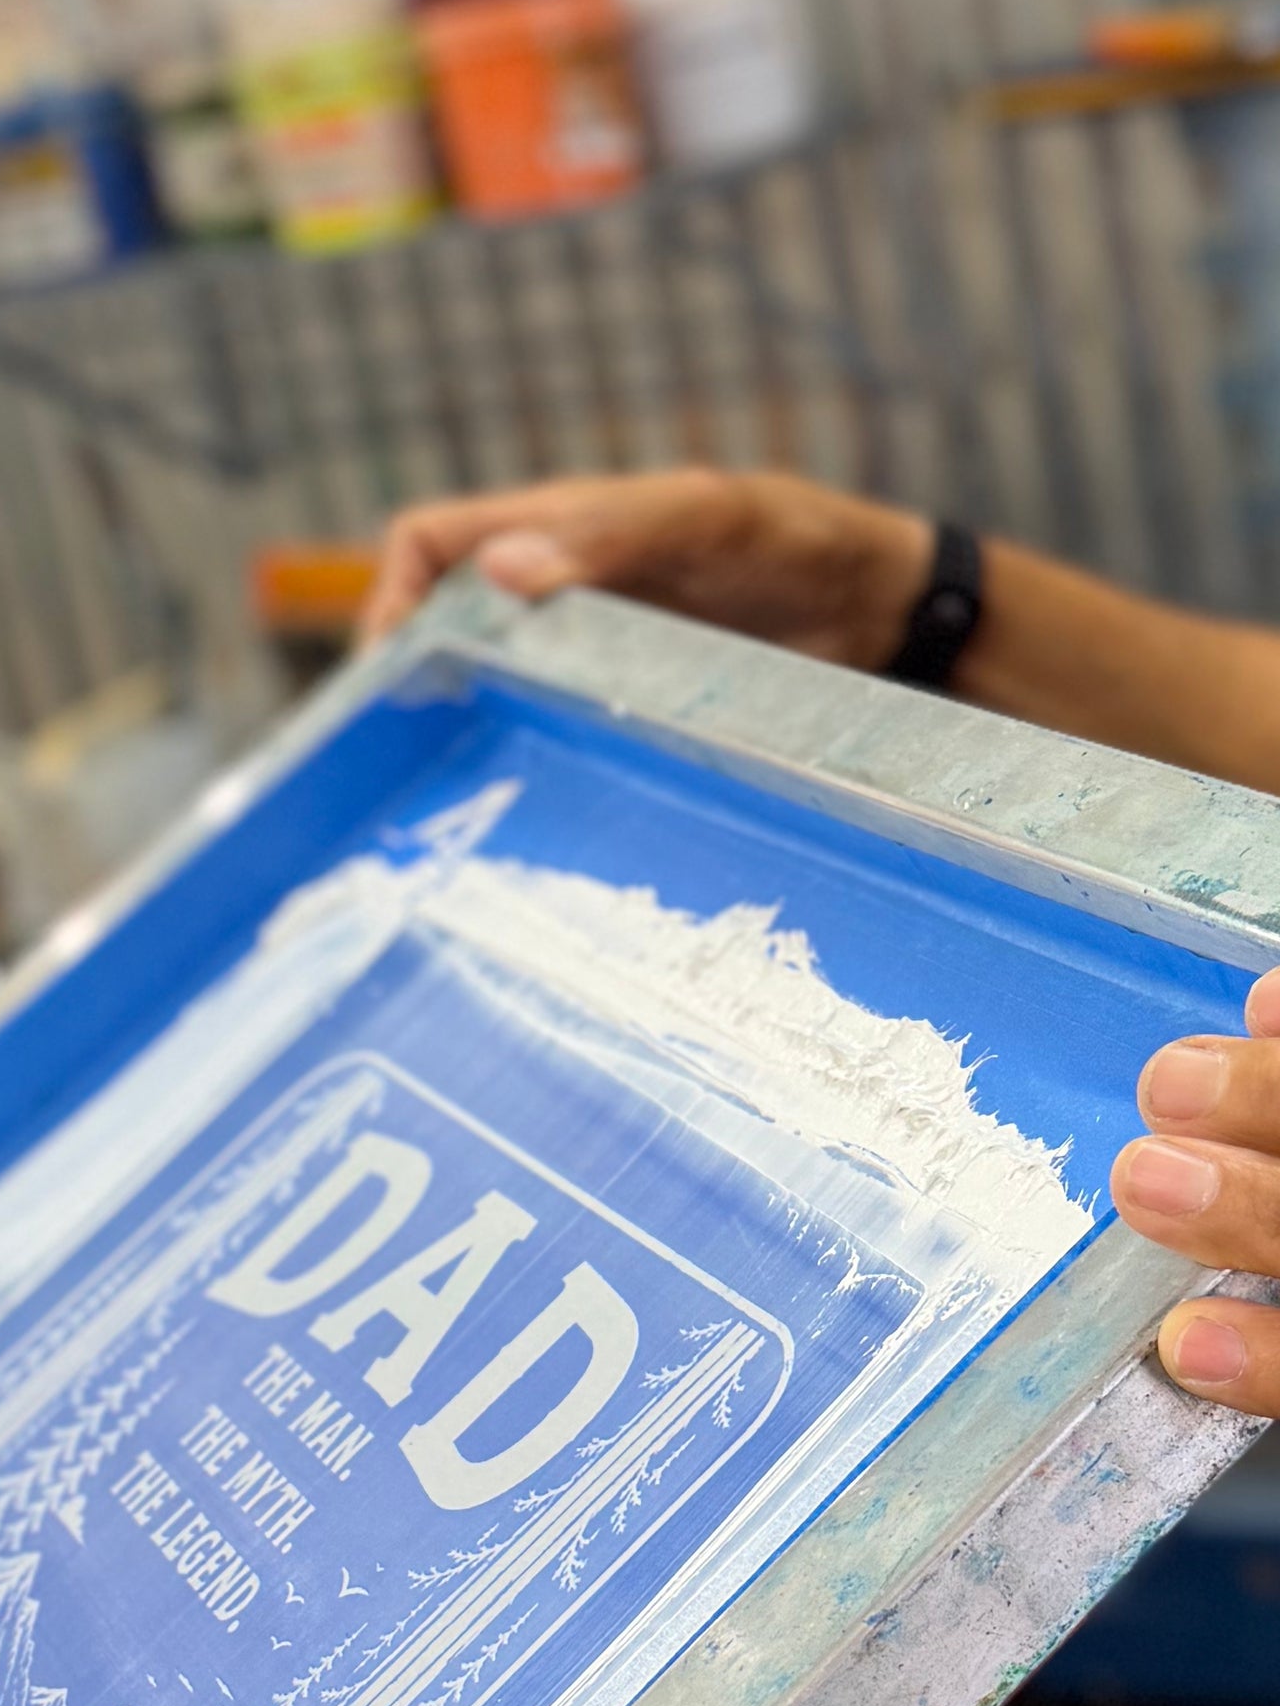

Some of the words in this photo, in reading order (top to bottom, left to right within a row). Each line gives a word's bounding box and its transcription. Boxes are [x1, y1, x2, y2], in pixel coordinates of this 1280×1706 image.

[204, 1131, 640, 1511] DAD
[179, 1403, 250, 1477] THE
[221, 1450, 316, 1555] MYTH.
[242, 1343, 316, 1418] THE
[287, 1389, 375, 1482] MAN.
[109, 1449, 181, 1527] THE
[149, 1497, 262, 1634] LEGEND.
